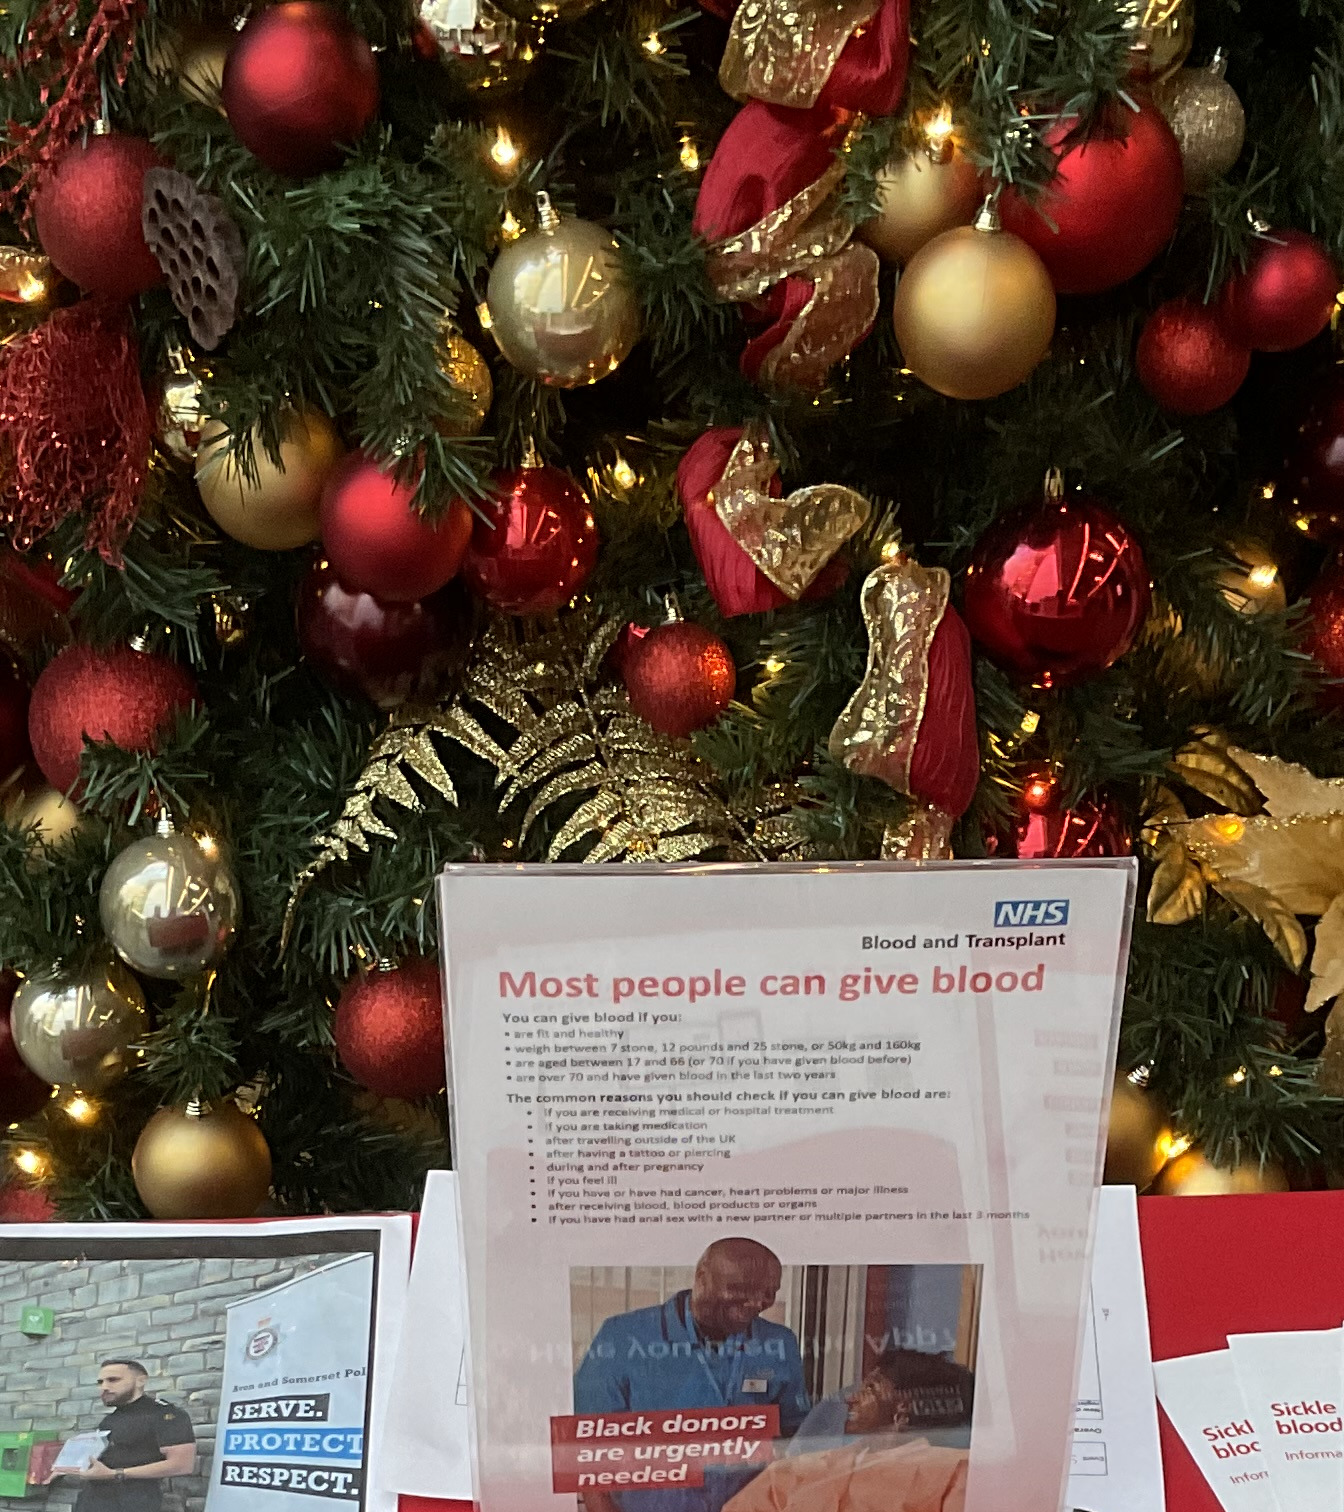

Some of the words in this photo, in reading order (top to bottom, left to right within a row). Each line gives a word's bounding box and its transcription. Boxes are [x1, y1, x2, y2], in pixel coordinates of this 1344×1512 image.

[996, 900, 1067, 925] NHS
[862, 934, 916, 949] Blood
[922, 933, 958, 948] and
[965, 931, 1065, 950] Transplant
[499, 971, 598, 997] Most
[612, 968, 746, 1003] people
[759, 974, 825, 995] can
[838, 966, 918, 1001] give
[932, 963, 1044, 993] blood
[502, 1012, 529, 1023] You
[533, 1015, 557, 1023] can
[561, 1012, 589, 1025] give
[594, 1011, 634, 1022] blood
[638, 1011, 647, 1022] if
[232, 1400, 323, 1420] SERVE.
[576, 1416, 652, 1437] Black
[662, 1413, 766, 1432] donors
[228, 1433, 363, 1454] PROTECT
[577, 1448, 624, 1463] are
[634, 1436, 760, 1462] urgently
[224, 1465, 359, 1495] RESPECT.
[578, 1464, 687, 1486] needed
